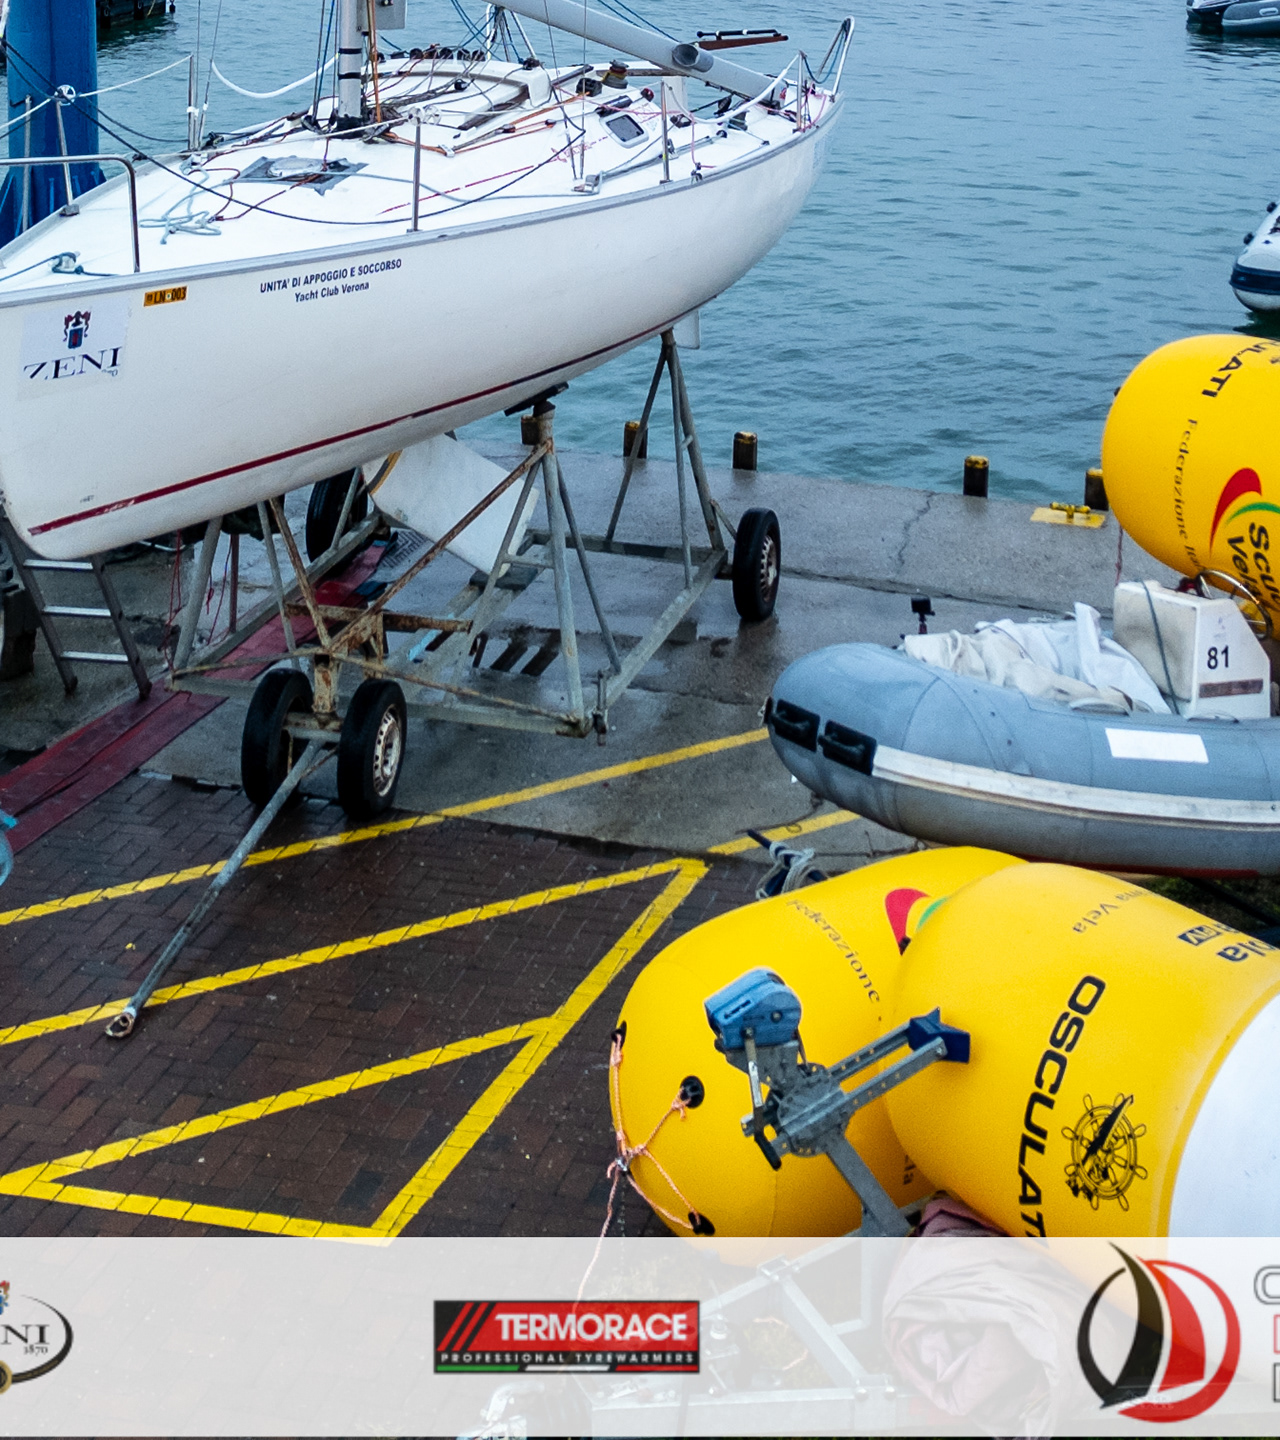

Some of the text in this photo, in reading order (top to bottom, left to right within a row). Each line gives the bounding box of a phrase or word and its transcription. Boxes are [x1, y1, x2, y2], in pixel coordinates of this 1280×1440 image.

[260, 258, 402, 293] UNITA' DI APPOGGIO E SOCCORSO
[295, 281, 369, 302] Yacht Club Verona
[23, 347, 123, 380] ZENI
[1207, 645, 1229, 670] 81
